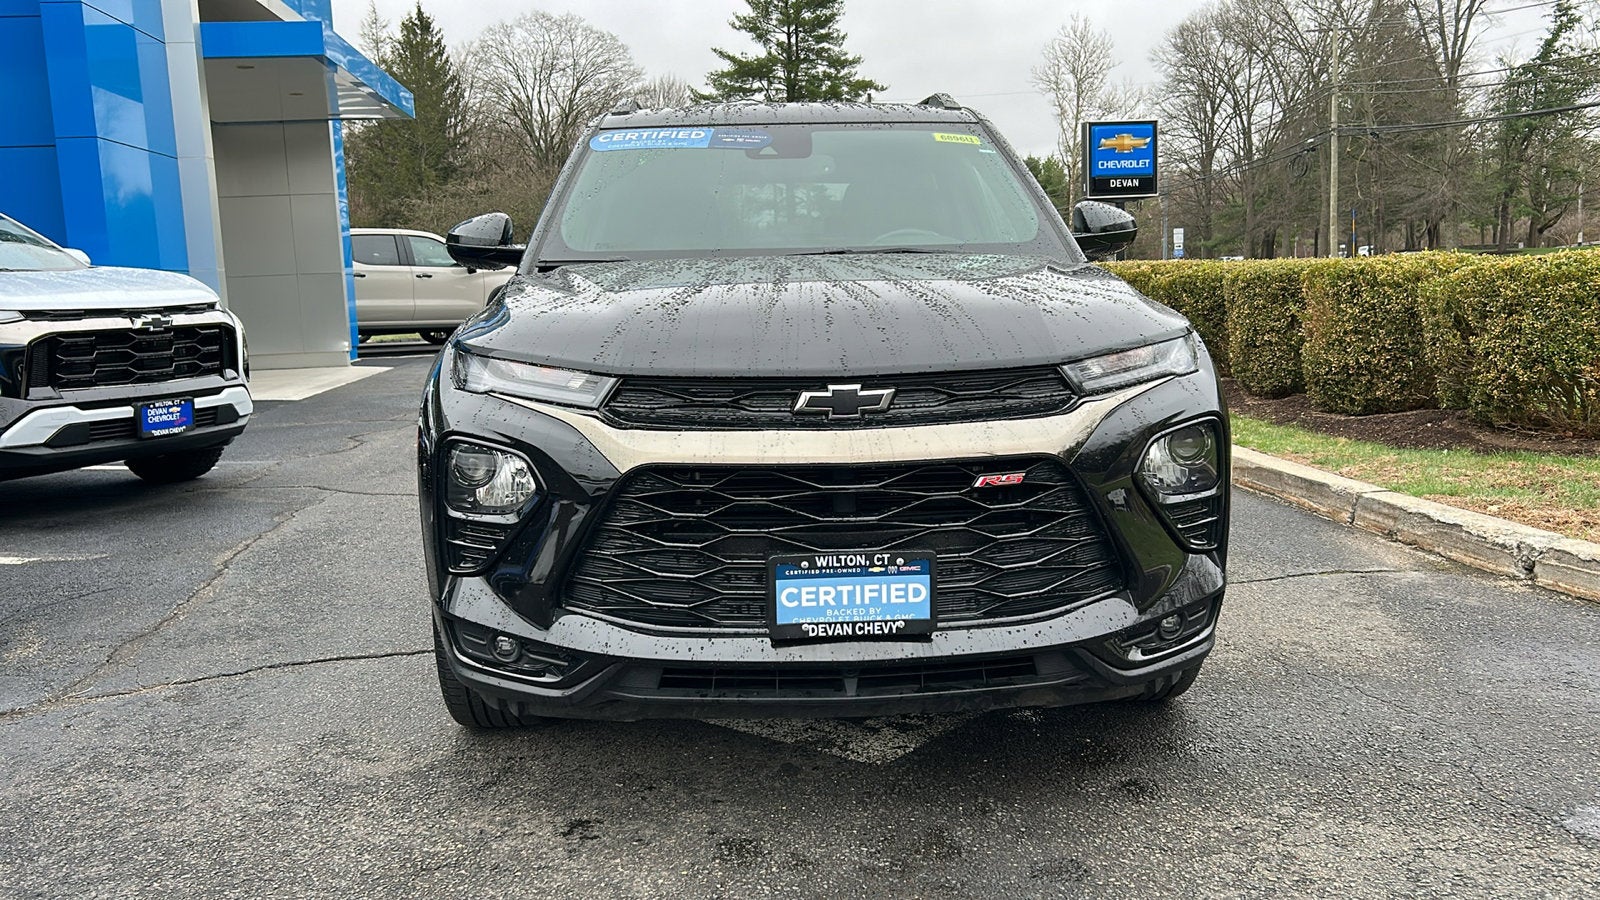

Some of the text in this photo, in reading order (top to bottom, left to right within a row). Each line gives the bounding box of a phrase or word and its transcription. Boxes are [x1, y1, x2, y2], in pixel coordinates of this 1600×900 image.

[598, 130, 706, 142] CERTIFIED
[1098, 159, 1150, 169] CHEVROLET
[1110, 179, 1139, 188] DEVAN
[147, 408, 168, 416] DEVAN
[147, 413, 181, 423] CHEVROLET
[973, 473, 1026, 487] RS
[815, 554, 891, 567] WILTON, CT
[780, 583, 927, 608] CERTIFIED
[826, 608, 866, 616] BACKED
[808, 621, 898, 637] DEVAN CHEVY
